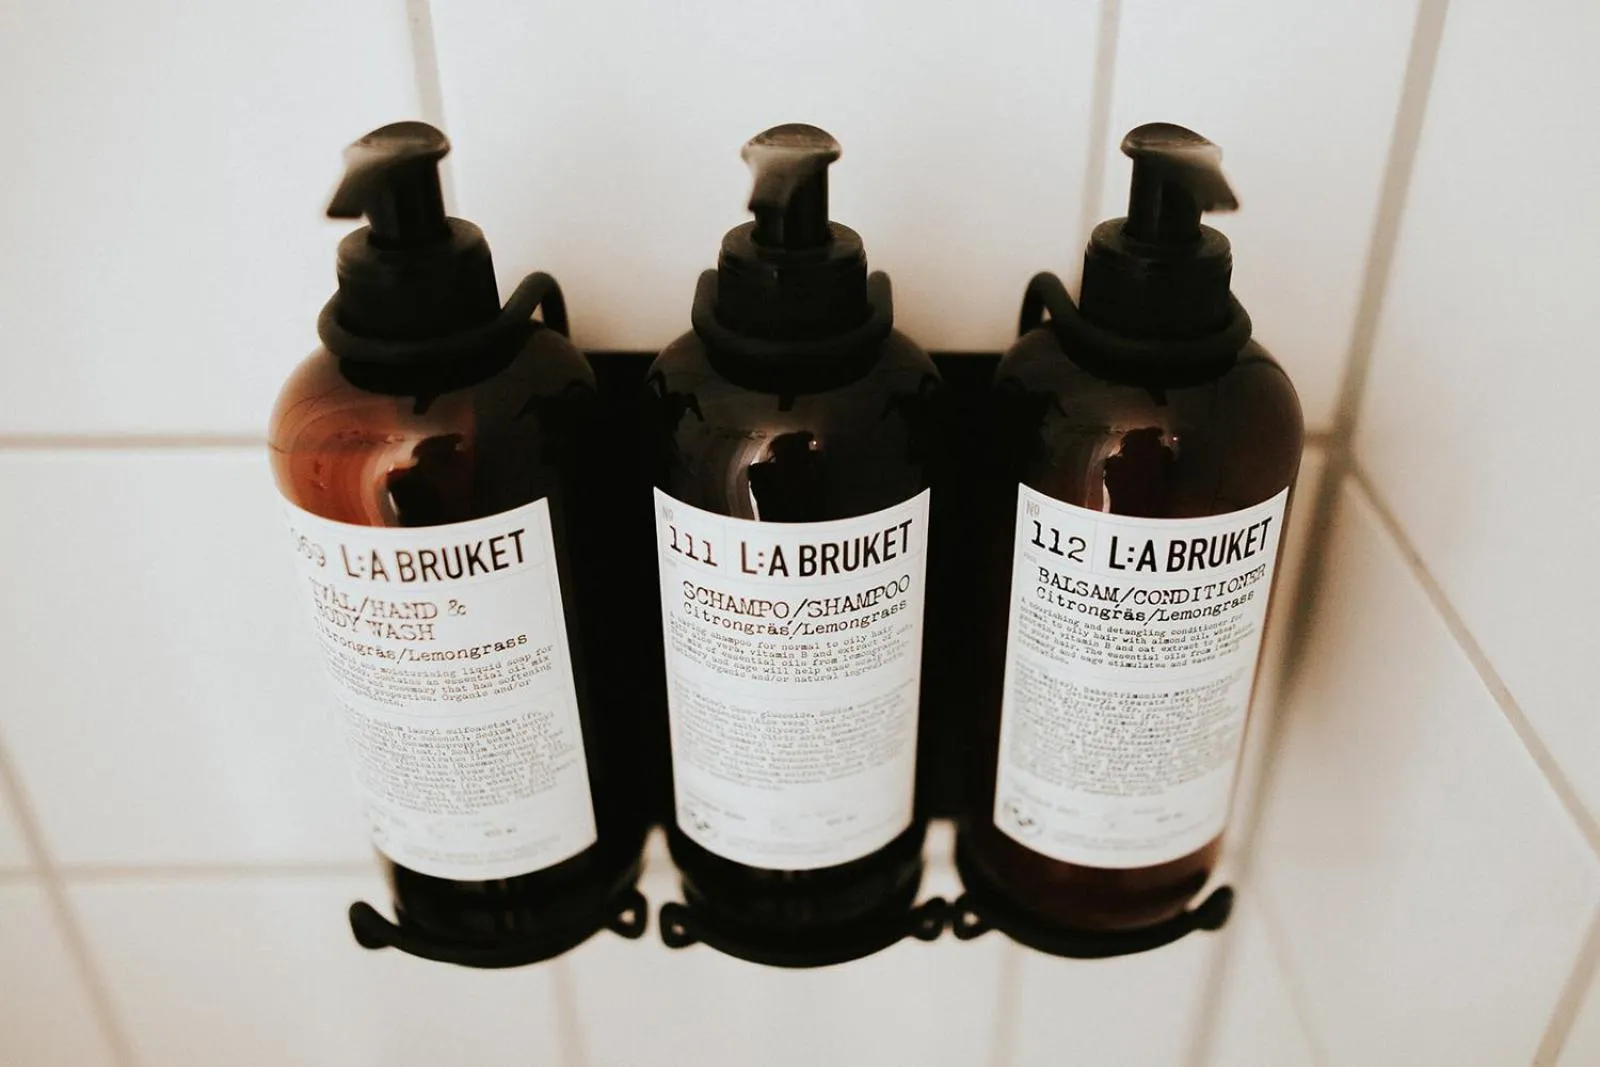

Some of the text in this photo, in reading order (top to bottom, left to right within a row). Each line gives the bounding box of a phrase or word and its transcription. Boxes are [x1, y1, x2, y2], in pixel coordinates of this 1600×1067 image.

[668, 518, 913, 577] 111 L:A BRUKET
[1031, 516, 1273, 573] 112 L:A BRUKET
[340, 528, 525, 583] L:A BRUKET
[1037, 563, 1266, 607] BALSAM/CONDITIONER
[683, 574, 910, 623] SCHAMPO/SHAMPOO
[1037, 587, 1255, 626] Citrongräs/Lemongrass
[684, 599, 907, 640] Citrongräs/Lemongrass
[366, 618, 435, 641] WASH
[1084, 622, 1102, 631] and
[1107, 627, 1166, 638] detangling
[1093, 631, 1118, 642] hair
[1122, 635, 1147, 645] with
[1151, 635, 1186, 645] almond
[757, 641, 776, 650] for
[781, 642, 820, 651] normal
[826, 641, 838, 649] to
[843, 634, 868, 646] oily
[1115, 643, 1134, 652] and
[1138, 643, 1156, 652] oat
[462, 663, 502, 677] liquid
[506, 654, 532, 668] soap
[535, 644, 554, 657] for
[812, 657, 838, 666] from
[813, 649, 832, 658] and
[1164, 652, 1186, 661] oils
[508, 663, 526, 674] oil
[531, 655, 550, 667] mix
[763, 665, 789, 675] will
[795, 666, 821, 676] help
[442, 684, 468, 694] that
